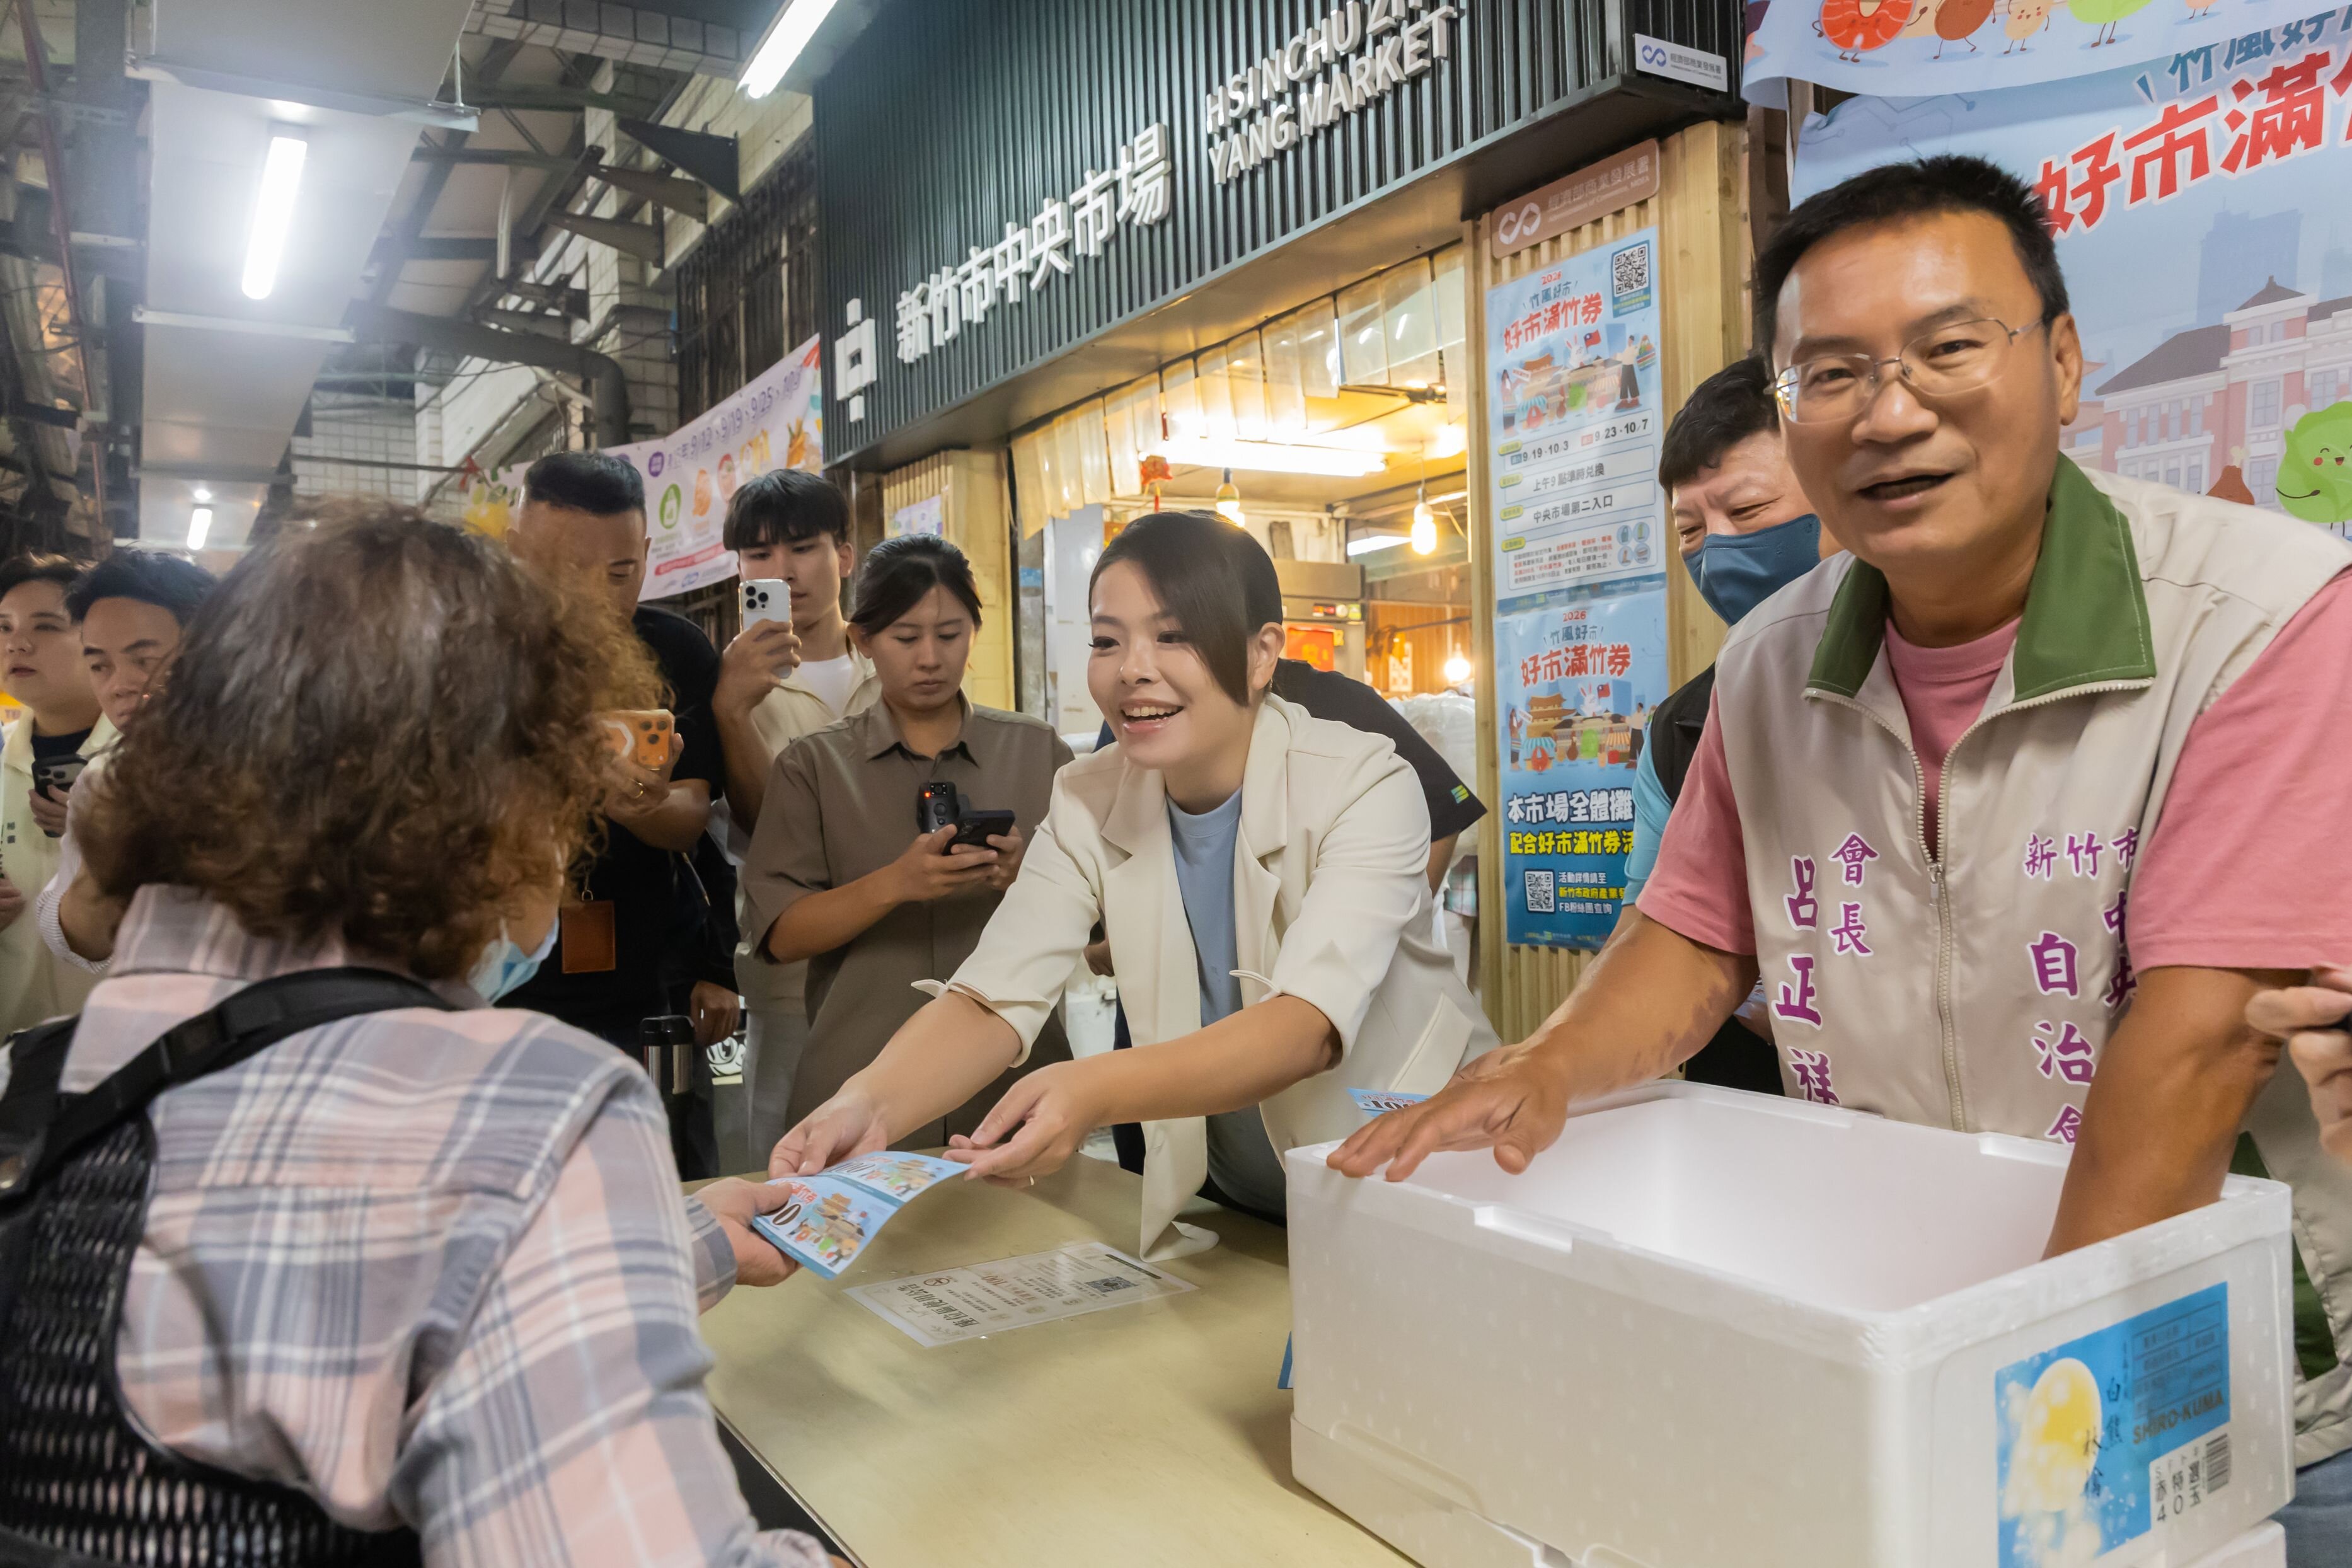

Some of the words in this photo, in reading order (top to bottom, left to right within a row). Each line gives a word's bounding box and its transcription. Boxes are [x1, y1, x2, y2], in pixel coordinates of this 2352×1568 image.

[1206, 1, 1361, 134] HSINCHU
[1209, 105, 1298, 184] YANG
[1300, 6, 1457, 137] MARKET
[2033, 50, 2352, 238] 好市滿
[896, 122, 1171, 363] 新竹市中央市場
[1503, 291, 1603, 354] 好市滿竹券
[1520, 643, 1632, 688] 好市滿竹券
[1563, 610, 1587, 622] 2026
[1829, 833, 1879, 955] 會長
